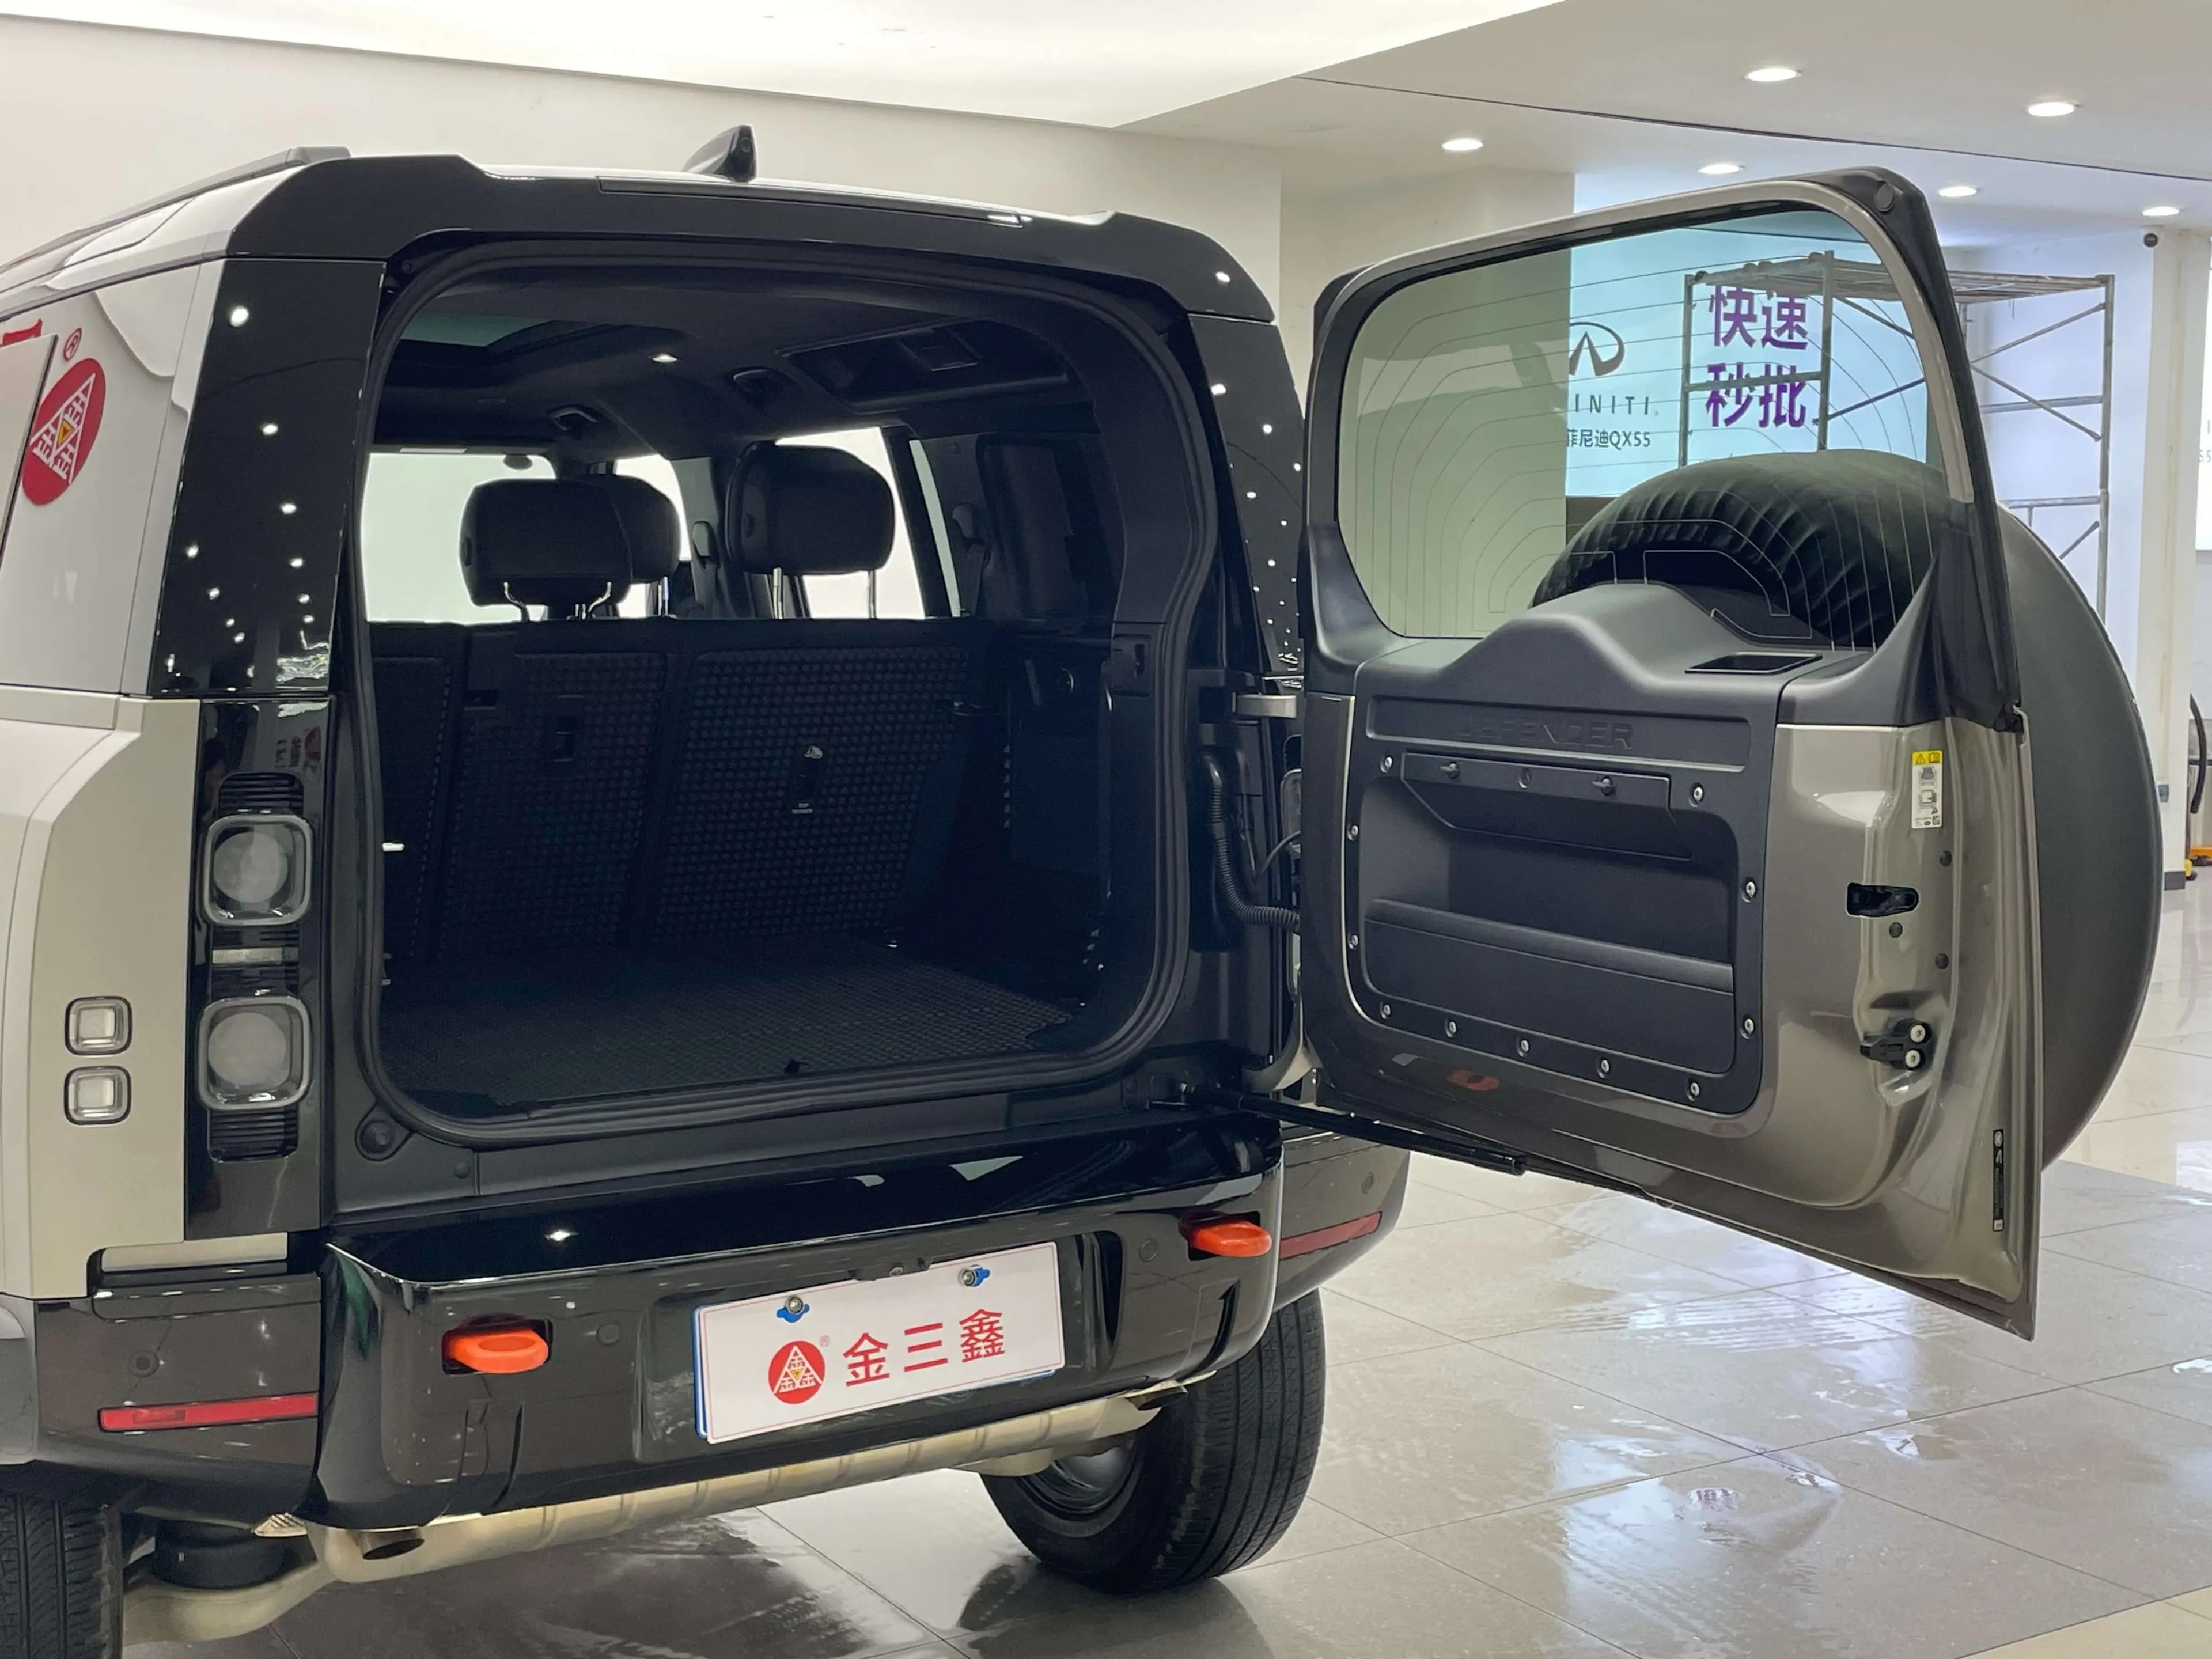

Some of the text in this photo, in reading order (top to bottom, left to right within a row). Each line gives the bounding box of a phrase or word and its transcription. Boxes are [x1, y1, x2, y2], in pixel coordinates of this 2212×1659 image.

[1709, 286, 1808, 349] 快速
[1706, 363, 1807, 427] 秒批
[843, 1309, 1005, 1387] 金三鑫
